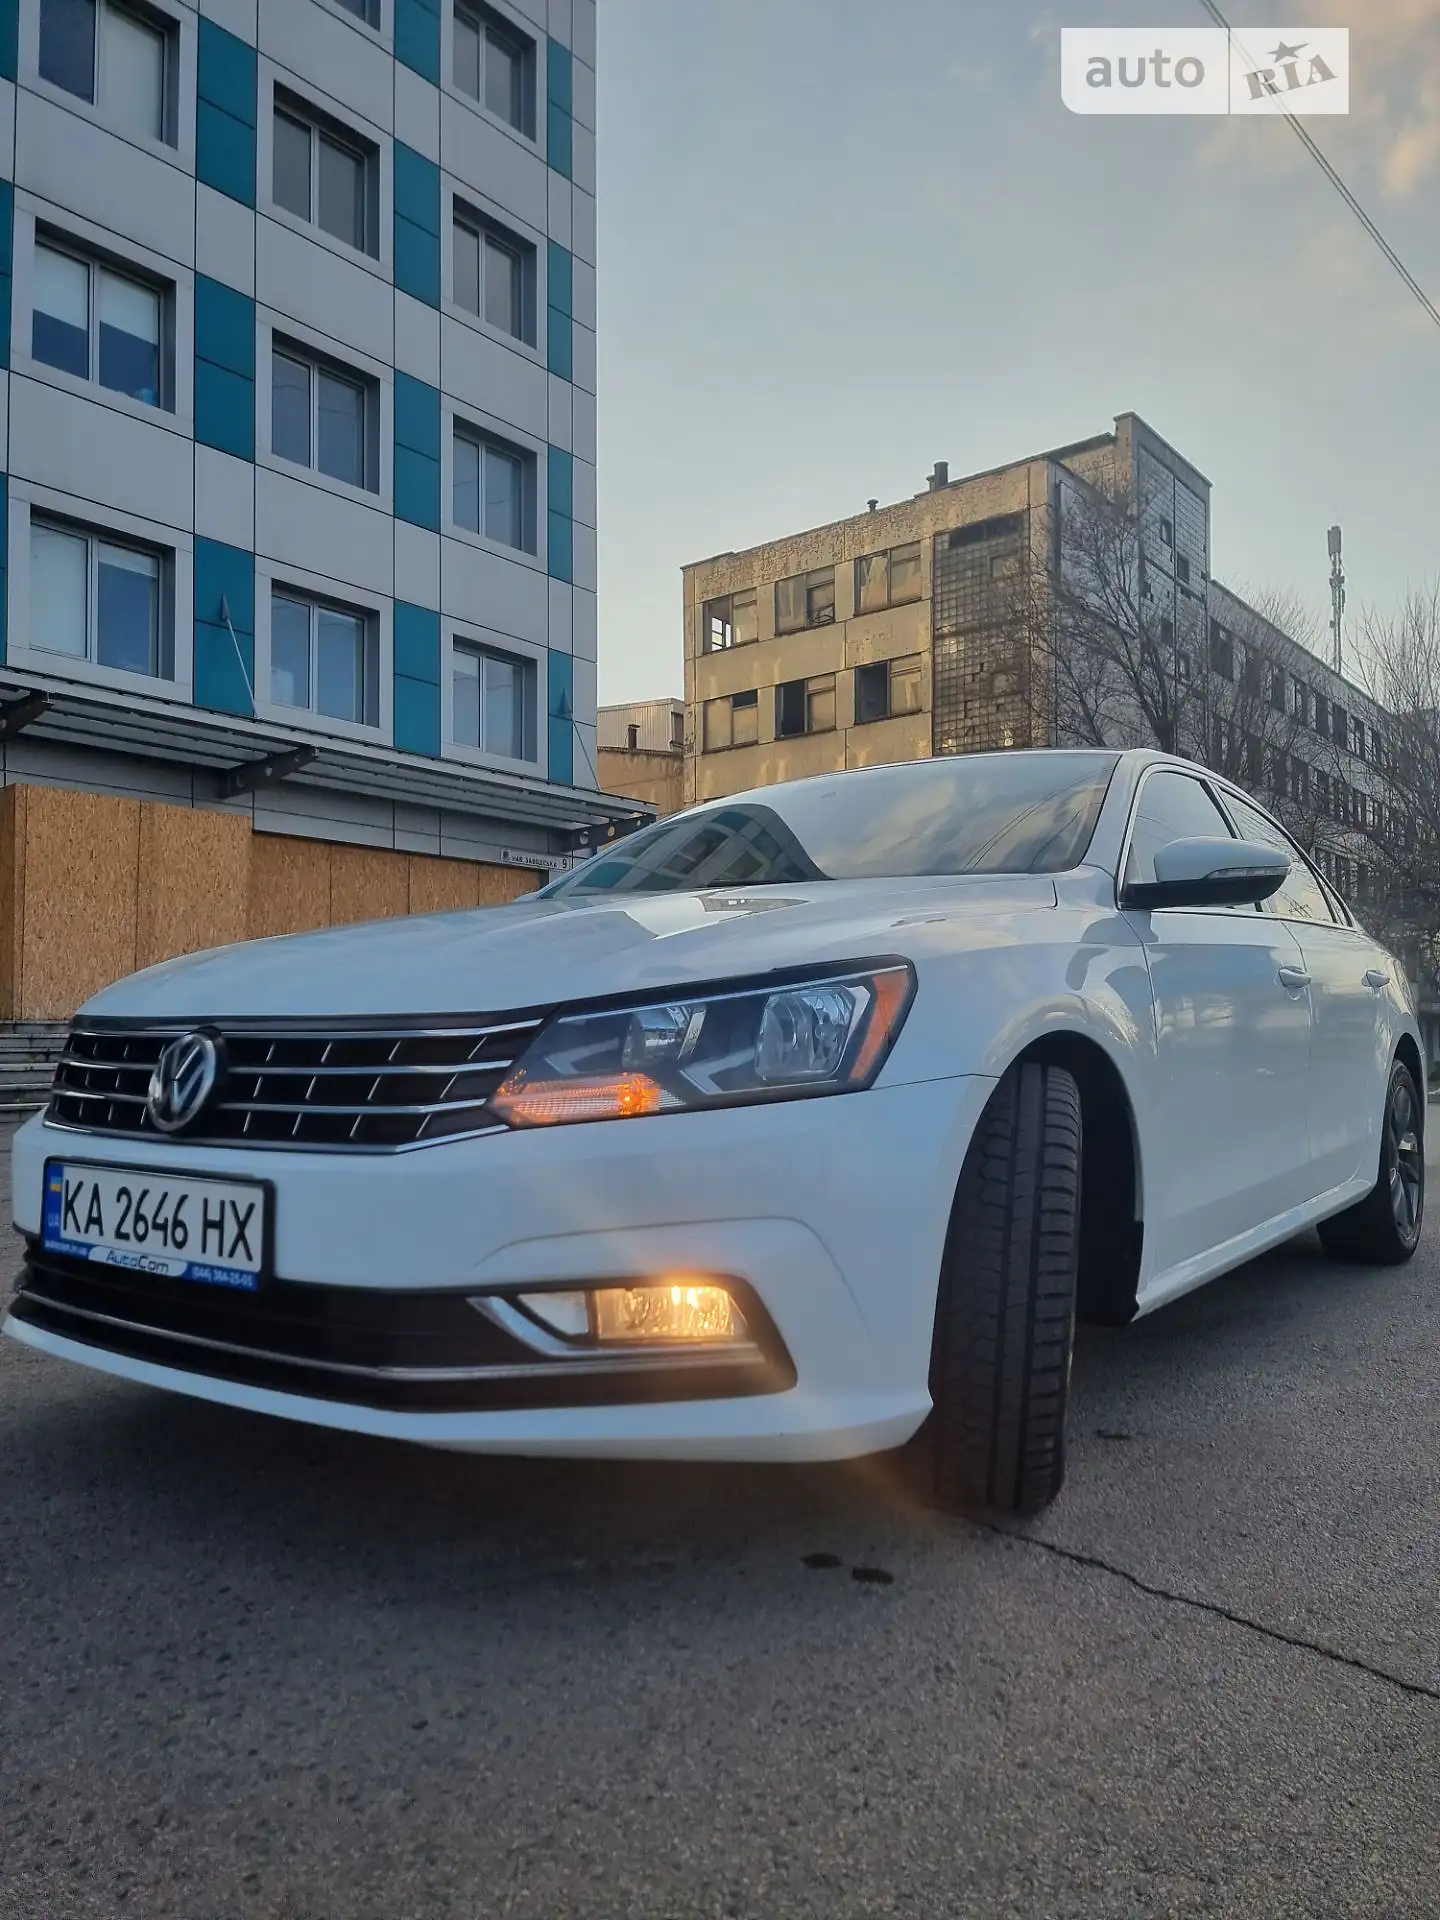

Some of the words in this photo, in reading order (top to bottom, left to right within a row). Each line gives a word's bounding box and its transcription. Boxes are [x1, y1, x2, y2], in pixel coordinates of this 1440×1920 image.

[562, 858, 568, 869] 9
[48, 1212, 60, 1227] UA
[63, 1180, 104, 1237] KA
[114, 1186, 188, 1250] 2646
[201, 1198, 255, 1262] HX
[106, 1249, 169, 1273] AutoCom
